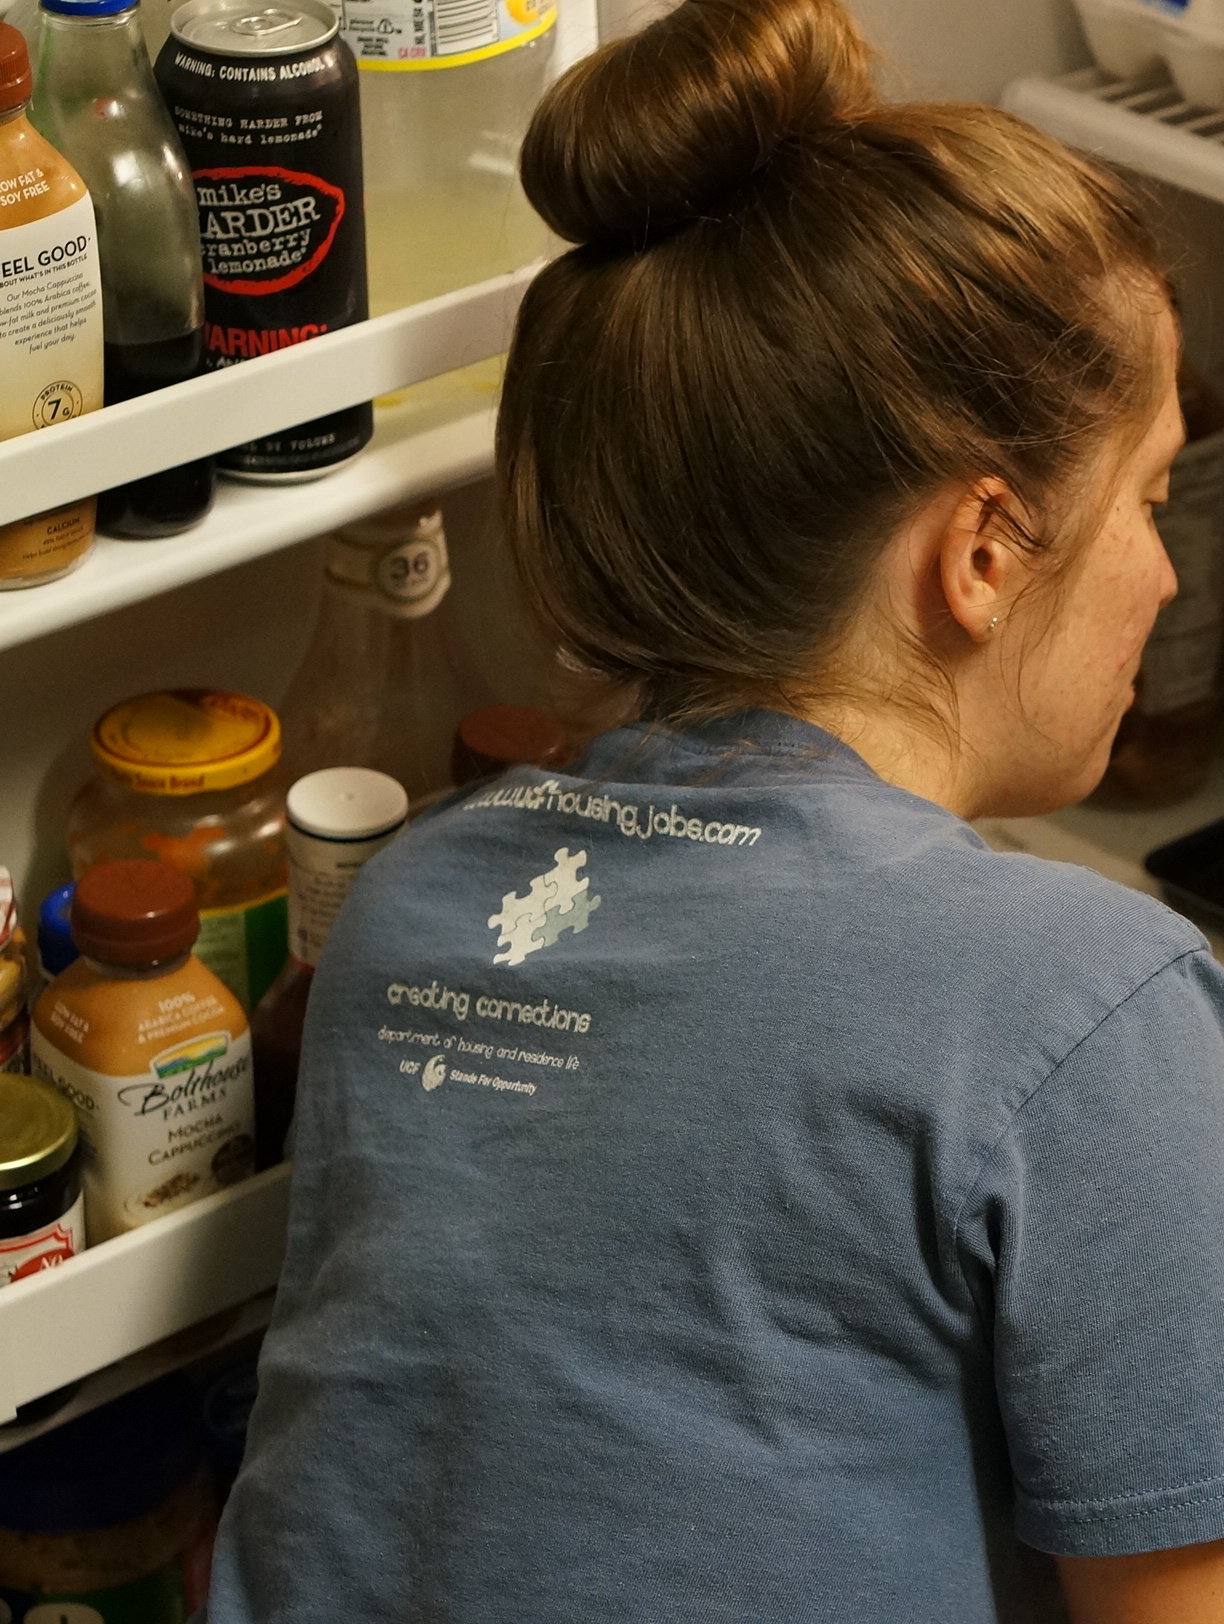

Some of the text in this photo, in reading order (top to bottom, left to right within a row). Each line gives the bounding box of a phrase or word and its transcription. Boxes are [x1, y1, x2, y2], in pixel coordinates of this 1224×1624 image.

[174, 51, 216, 78] WARNING:
[219, 65, 277, 82] CONTAINS
[174, 105, 323, 130] SOMETHING HARDER FROM
[178, 121, 214, 141] mike's
[220, 131, 253, 145] hard
[0, 167, 45, 193] OW FAT &
[0, 180, 51, 207] SOY FREE
[196, 182, 282, 207] mike's
[200, 196, 322, 240] ARDER
[0, 252, 88, 289] BOUT WHAT'S IN THIS BOTTLE
[1, 235, 88, 279] EEL GOOD
[6, 272, 84, 303] Our Mocha Cappuccino
[23, 297, 43, 309] 100%
[44, 289, 71, 303] Arabica
[7, 325, 31, 337] create
[37, 311, 75, 328] deliciously
[75, 301, 97, 316] smooth
[20, 311, 35, 322] milk
[35, 304, 50, 317] and
[50, 298, 80, 314] premium
[80, 289, 97, 302] cocoa
[14, 317, 88, 346] experience that helps
[28, 343, 43, 355] fuel
[43, 337, 60, 350] your
[40, 383, 73, 401] PROTEIN
[46, 517, 81, 535] CALCIUM
[390, 551, 430, 580] 36
[158, 991, 196, 1013] 100%
[387, 979, 592, 1034] creating connections
[377, 1024, 580, 1070] department of housing and residence life
[399, 1059, 538, 1097] UCF Stands For Opportunity
[162, 1089, 227, 1121] FARMS
